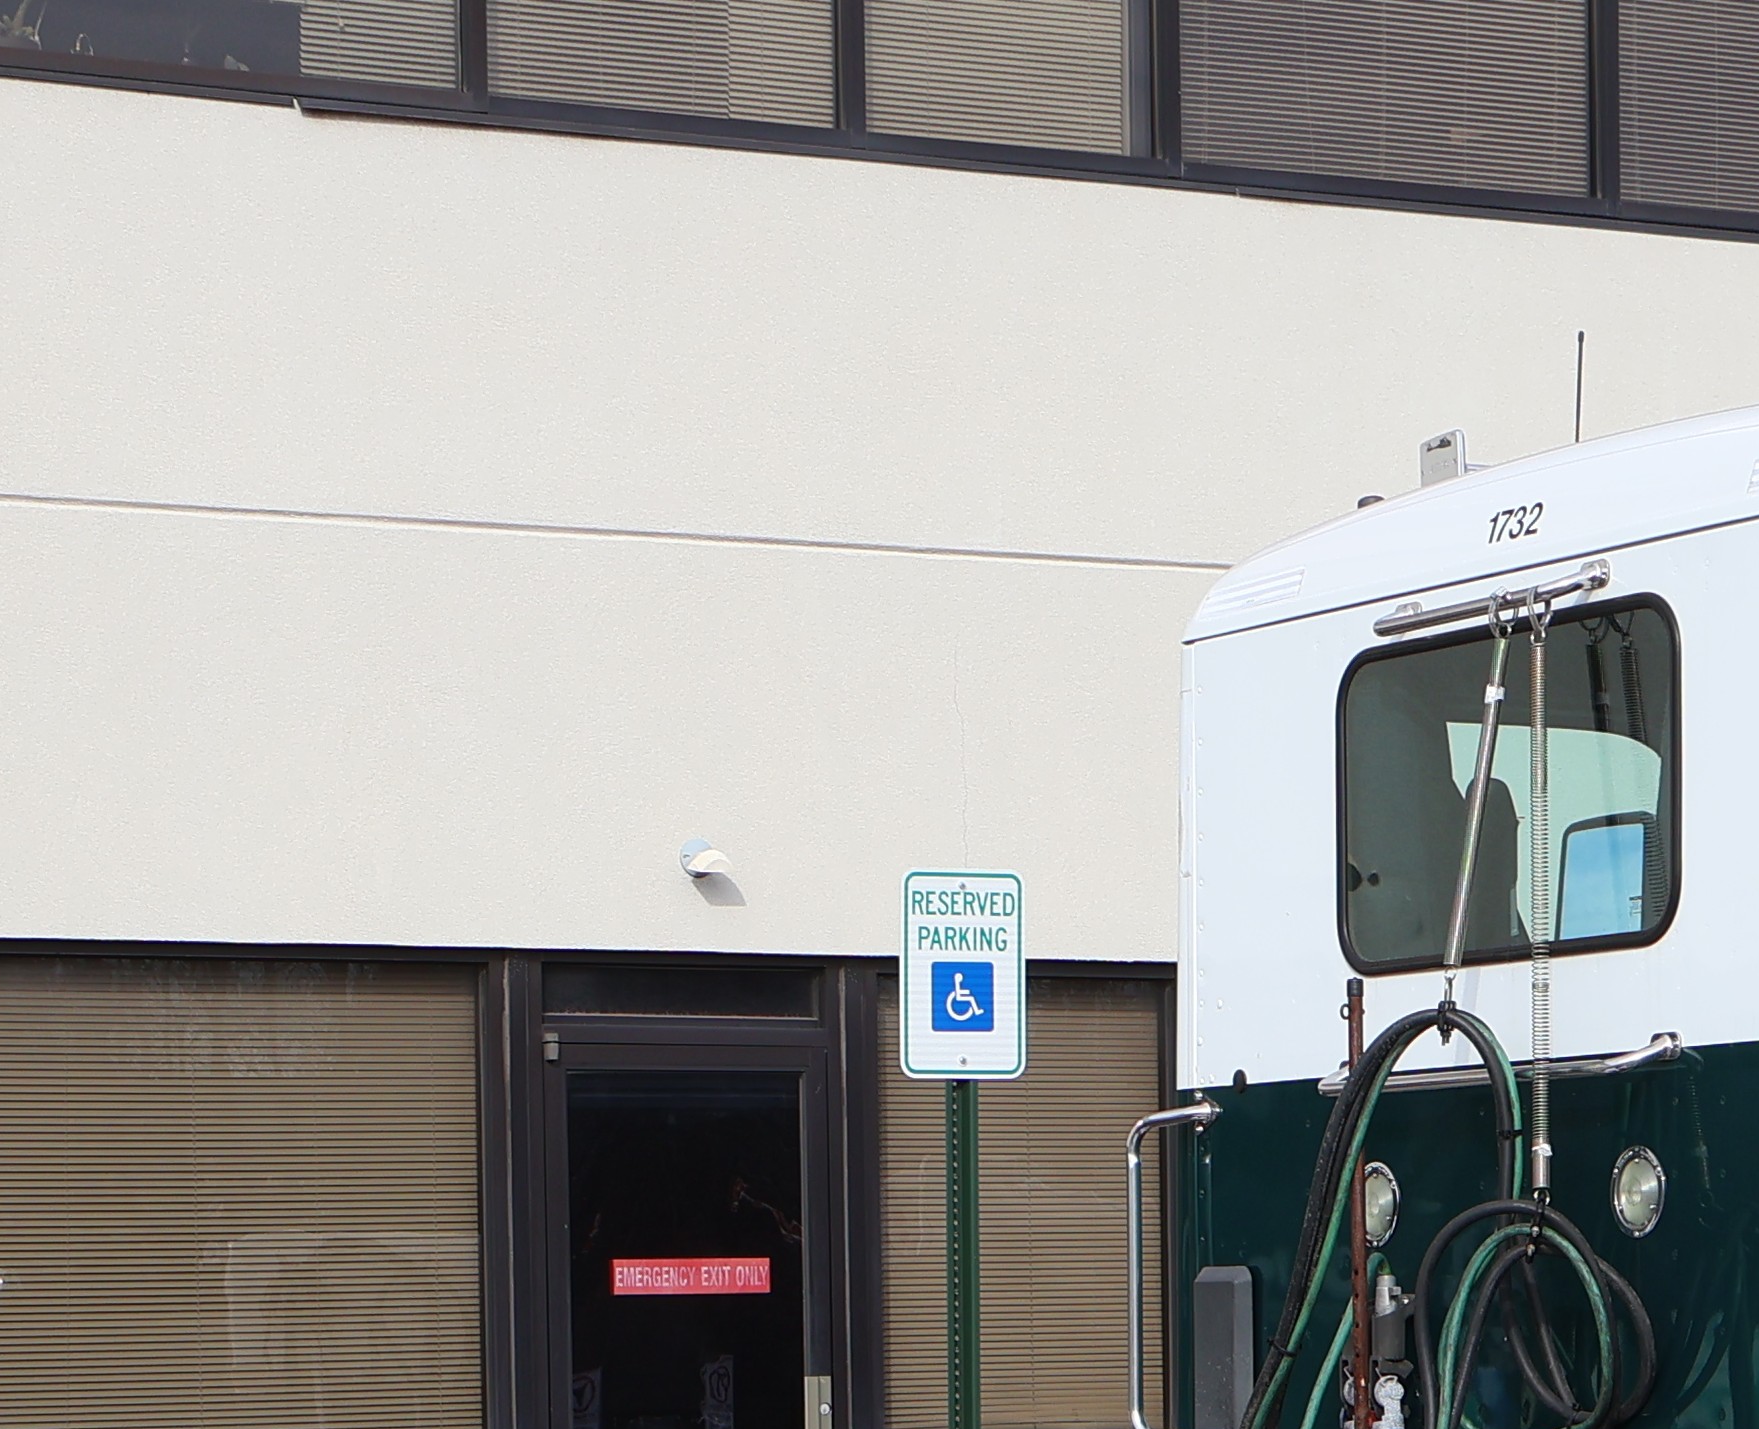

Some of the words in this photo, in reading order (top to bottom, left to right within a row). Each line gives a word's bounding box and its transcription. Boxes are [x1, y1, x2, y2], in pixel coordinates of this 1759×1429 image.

[1488, 501, 1544, 544] 1732
[912, 890, 1016, 917] RESERVED
[918, 926, 1008, 952] PARKING
[615, 1266, 696, 1287] EMERGENCY
[701, 1266, 731, 1287] EXIT
[735, 1265, 769, 1286] ONLY
